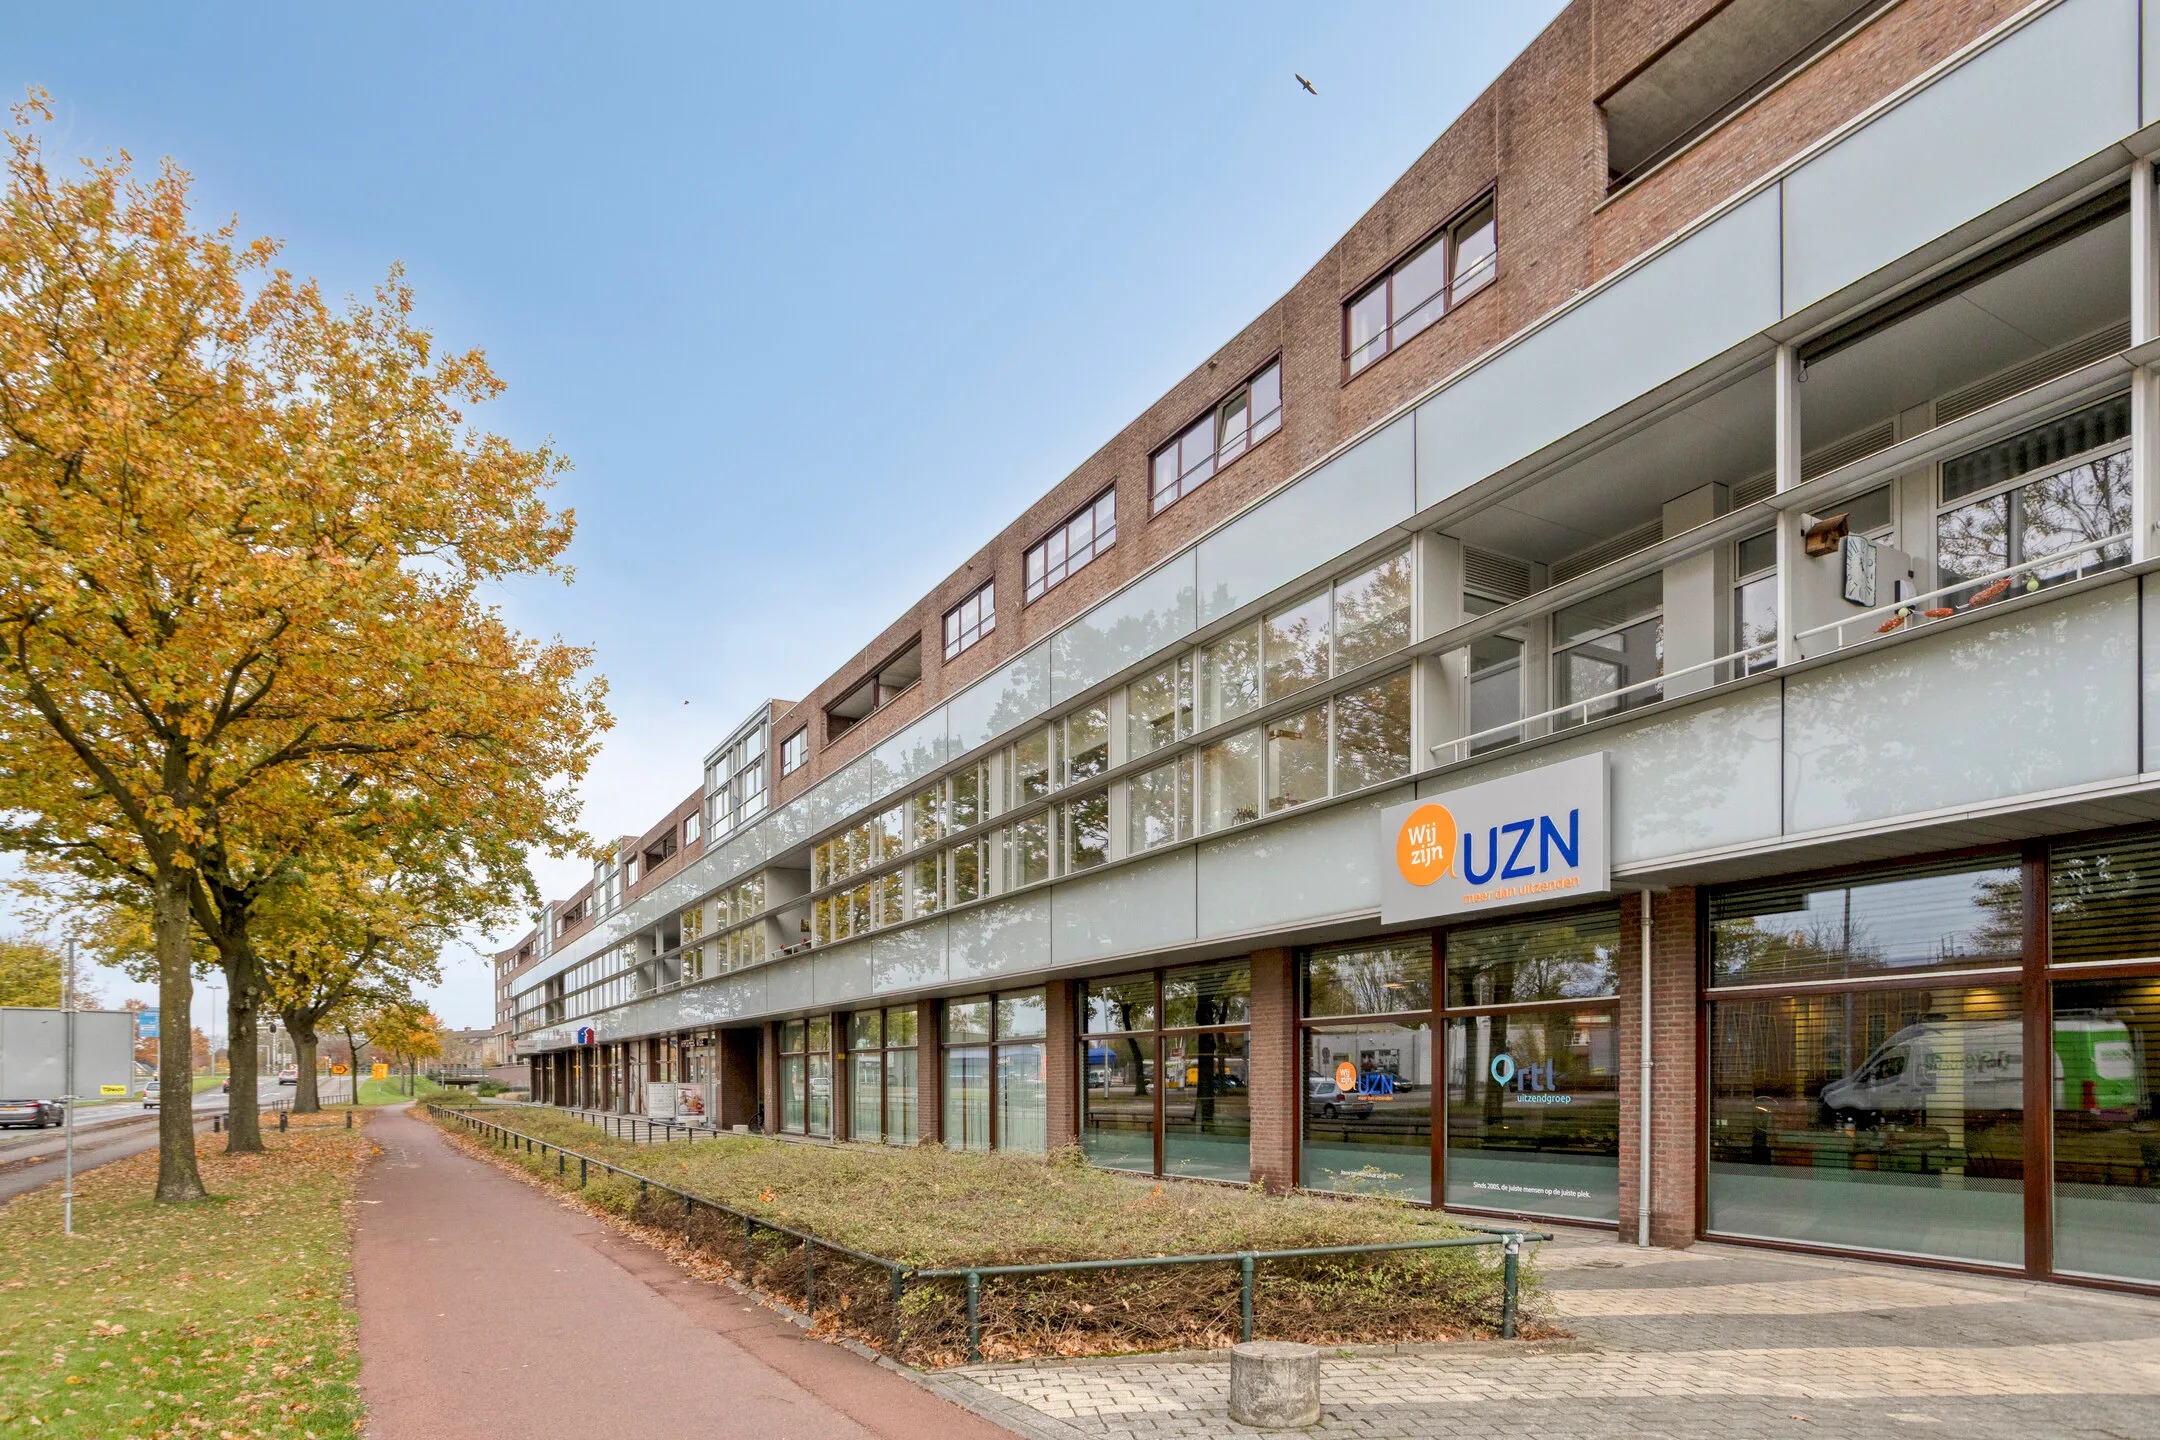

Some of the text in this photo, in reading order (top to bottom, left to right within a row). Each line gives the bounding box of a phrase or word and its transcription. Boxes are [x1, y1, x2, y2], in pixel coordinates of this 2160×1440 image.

[1408, 822, 1437, 846] Wij
[1411, 844, 1443, 867] zijn
[1463, 808, 1579, 886] UZN
[1463, 875, 1580, 904] meer dan uitzenden
[1358, 1074, 1393, 1095] UZN
[1517, 1094, 1571, 1104] uitzendgroep
[1473, 1181, 1486, 1189] Sinds
[1561, 1189, 1576, 1197] juiste
